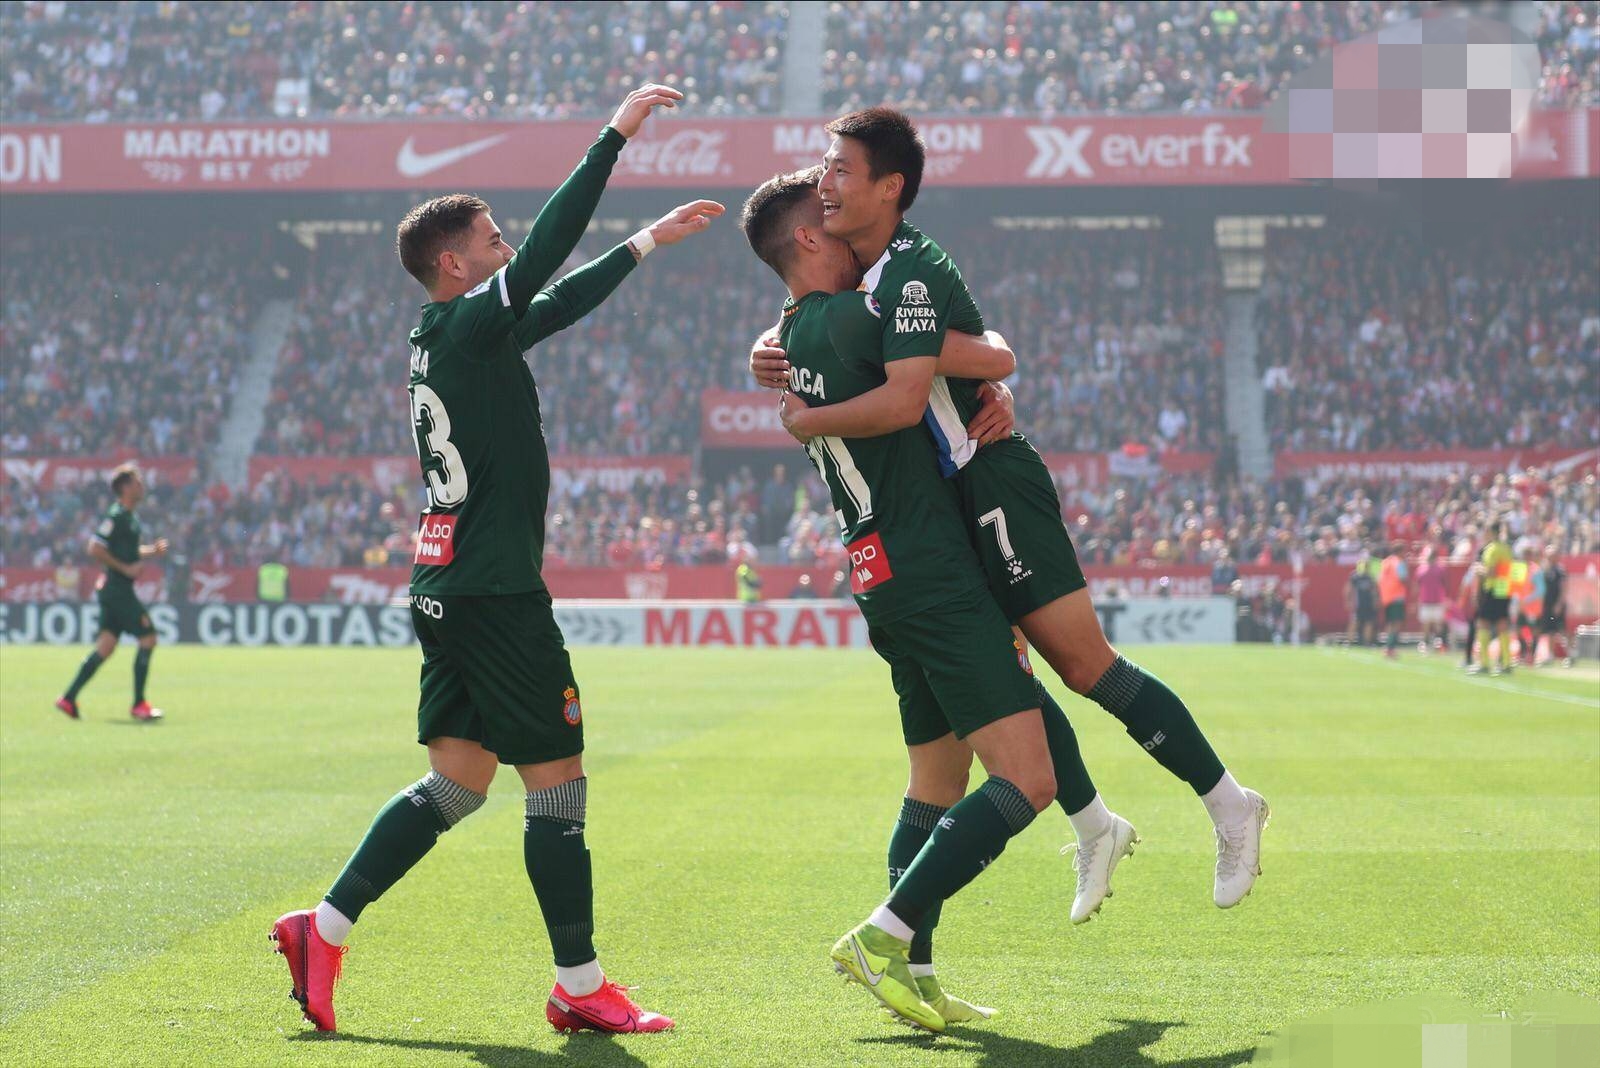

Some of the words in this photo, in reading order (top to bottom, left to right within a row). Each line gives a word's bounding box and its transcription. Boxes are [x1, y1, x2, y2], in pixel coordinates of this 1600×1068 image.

[124, 128, 331, 158] MARATHON
[1101, 123, 1253, 168] everfx
[201, 161, 253, 182] BET
[895, 318, 937, 334] MAYA
[896, 306, 937, 318] RIVIERA
[789, 366, 826, 401] OCA
[978, 506, 1015, 560] 7
[1009, 569, 1033, 585] KELME
[202, 602, 412, 647] CUOTAS
[643, 606, 872, 648] MARAT
